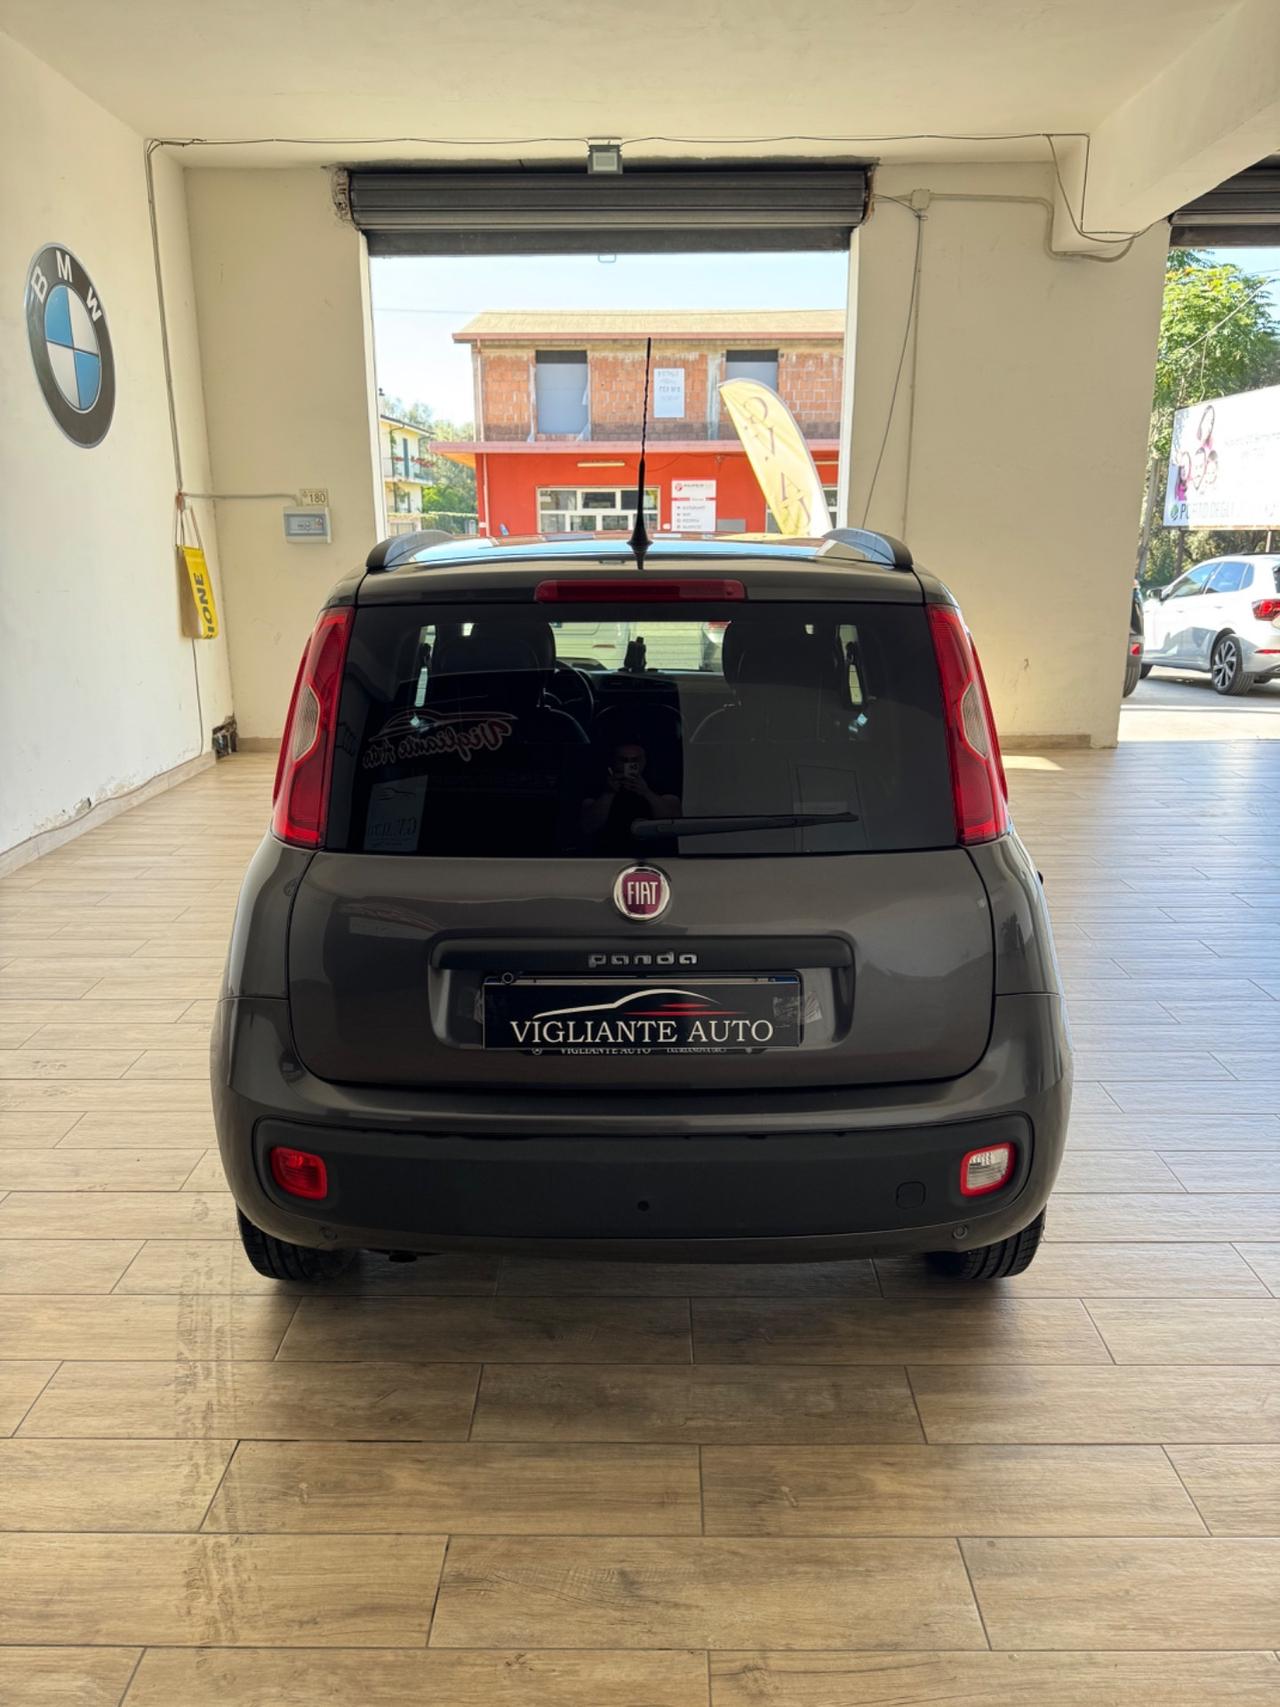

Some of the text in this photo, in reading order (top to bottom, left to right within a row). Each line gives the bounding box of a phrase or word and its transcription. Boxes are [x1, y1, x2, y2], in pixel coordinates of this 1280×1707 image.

[31, 249, 102, 322] BMW
[310, 493, 326, 504] 180
[627, 881, 658, 905] FIAT
[588, 952, 697, 968] panda
[510, 1020, 774, 1043] VIGLIANTE AUTO
